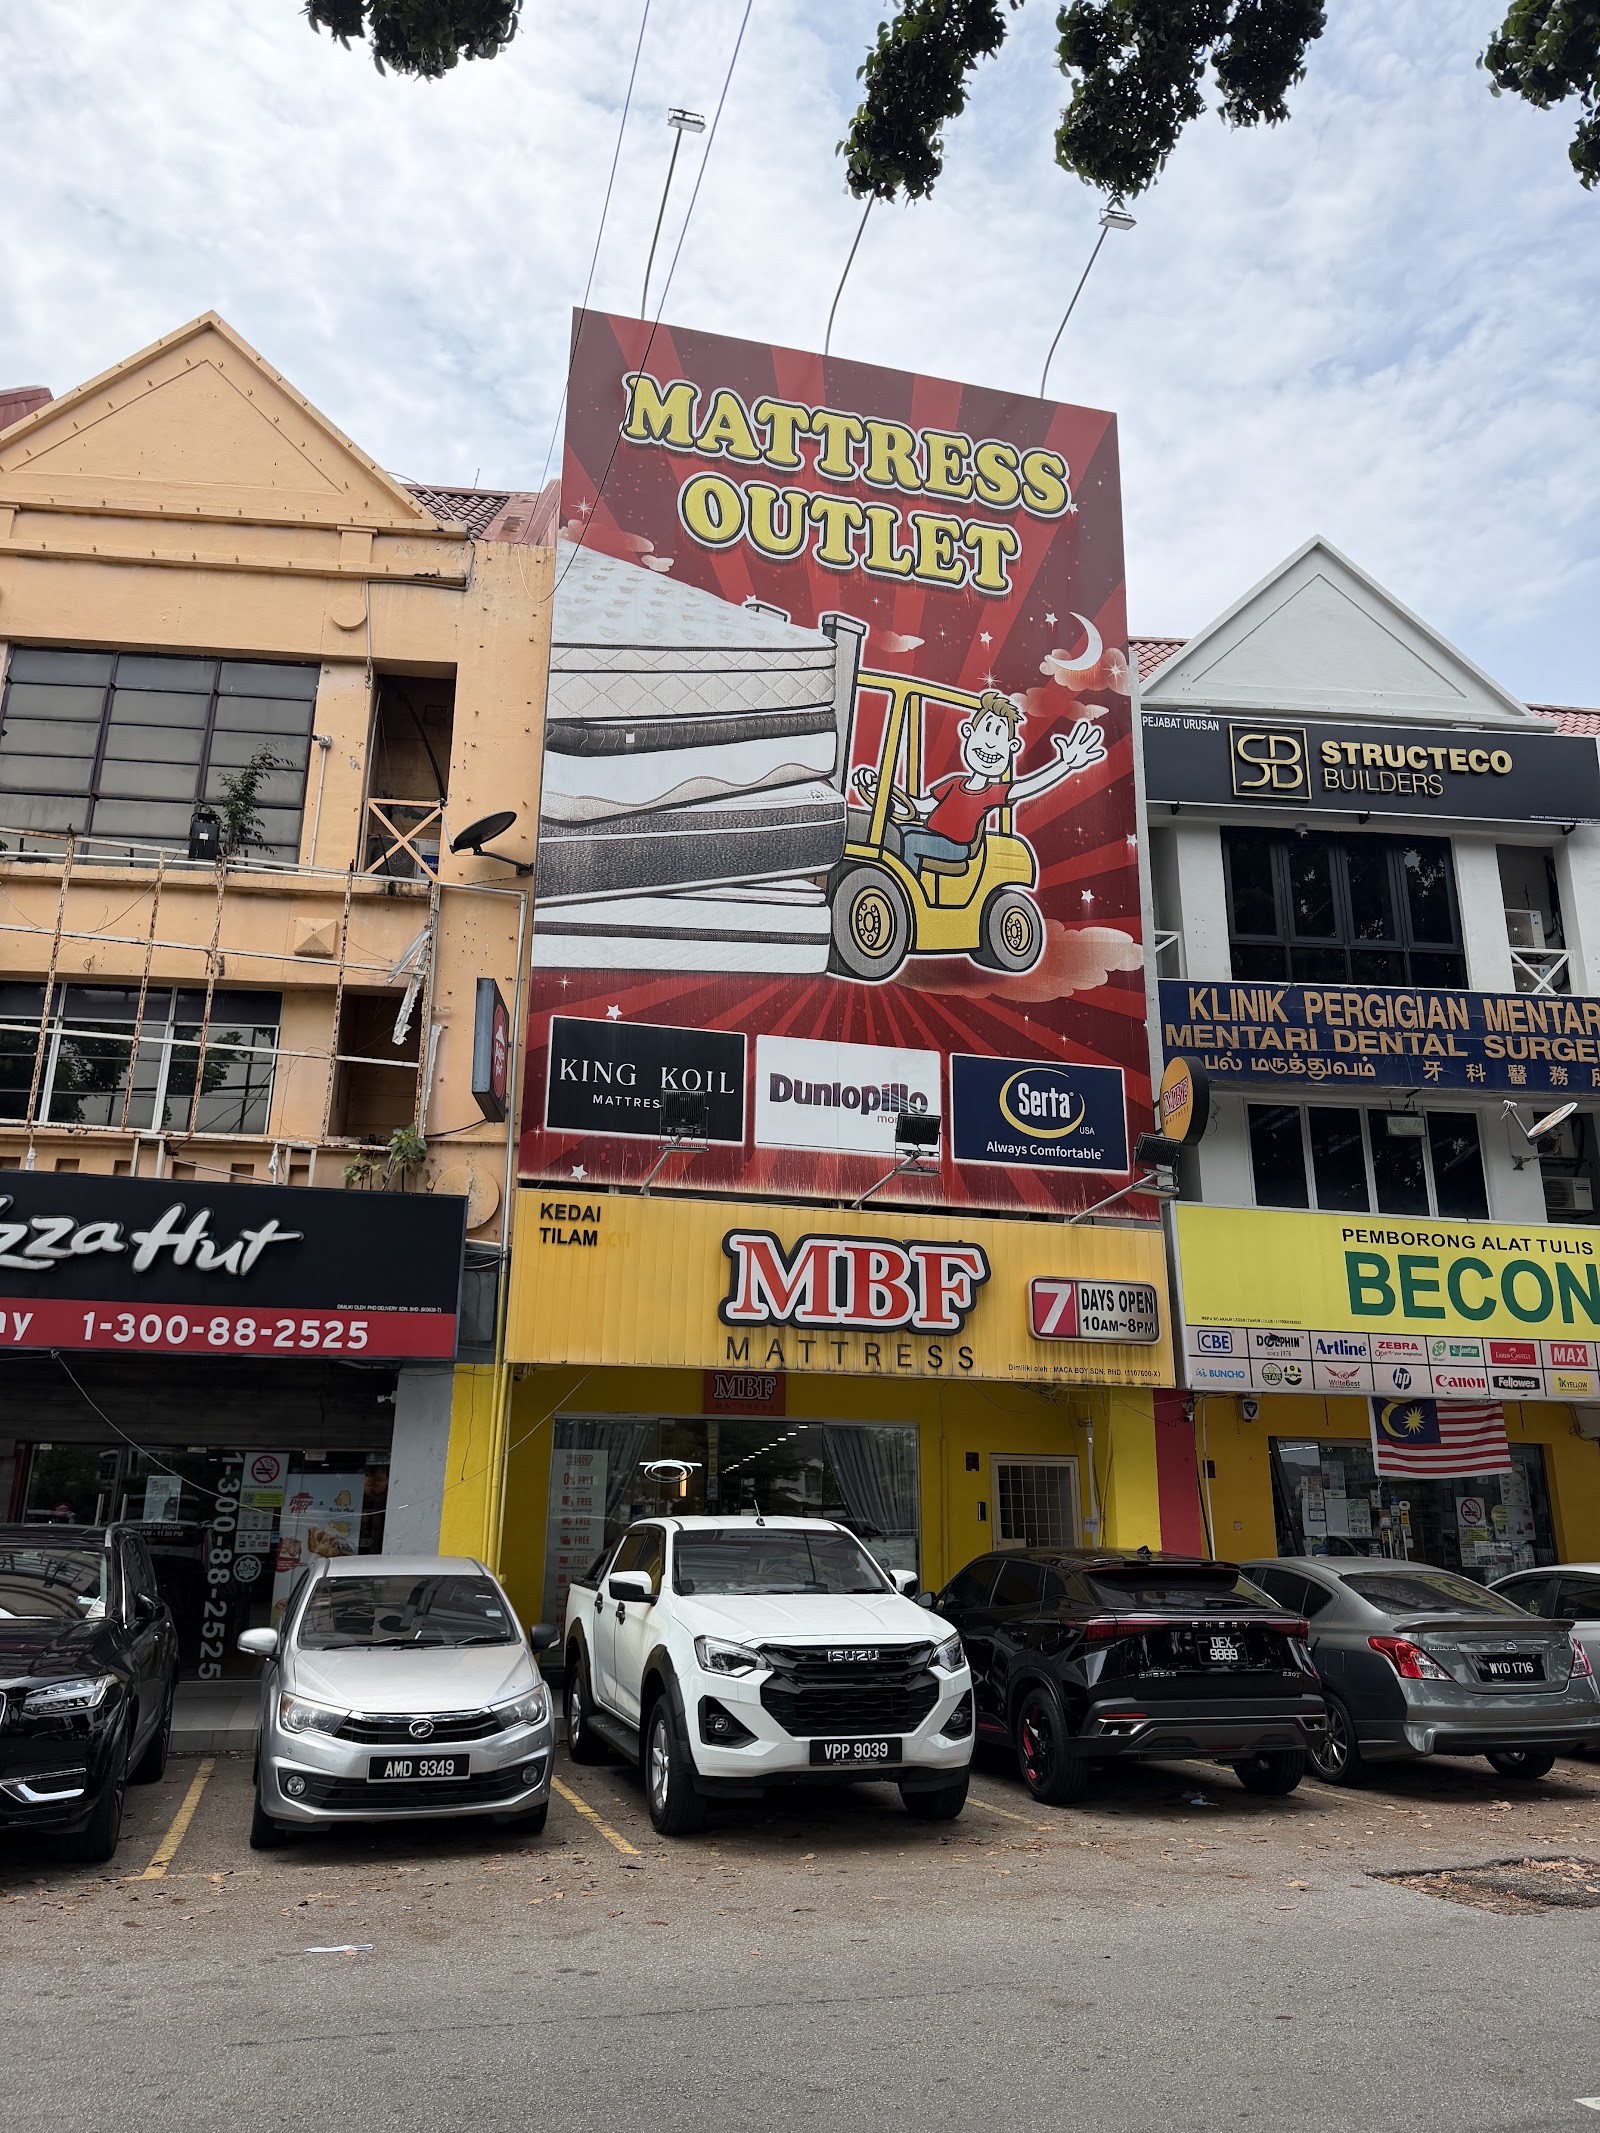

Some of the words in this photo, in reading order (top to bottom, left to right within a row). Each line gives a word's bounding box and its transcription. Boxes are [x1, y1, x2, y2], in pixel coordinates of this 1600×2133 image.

[623, 372, 1069, 516] MATTRESS
[679, 472, 1018, 594] OUTLET
[1142, 716, 1181, 730] PEJABAT
[1183, 718, 1219, 731] URUSAN
[1321, 740, 1514, 775] STRUCTECO
[1323, 768, 1445, 797] BUILDERS
[1189, 987, 1288, 1023] KLINIK
[1305, 992, 1470, 1032] PERGIGIAN
[1165, 1024, 1317, 1052] MENTARI
[1335, 1030, 1471, 1057] DENTAL
[1483, 1034, 1600, 1065] SURGE
[1204, 1050, 1243, 1071] பல்
[1251, 1052, 1376, 1080] மருத்துவம்
[559, 1058, 638, 1087] KING
[660, 1066, 735, 1095] KOIL
[769, 1072, 929, 1116] Dunlopillo
[1018, 1082, 1071, 1119] Serta
[1163, 1076, 1189, 1117] MBF
[1079, 1126, 1095, 1136] USA
[986, 1141, 1027, 1157] Always
[1029, 1143, 1102, 1160] Comfortable
[540, 1203, 601, 1223] KEDAI
[132, 1202, 302, 1276] Hut
[539, 1227, 598, 1247] TILAM
[1341, 1228, 1476, 1249] PEMBORONG
[1481, 1236, 1531, 1252] ALAT
[1536, 1239, 1594, 1255] TULIS
[718, 1229, 991, 1335] MBF
[1034, 1282, 1072, 1334] 7
[1081, 1288, 1114, 1311] DAYS
[1119, 1290, 1155, 1314] OPEN
[82, 1311, 369, 1350] 1-300-88-2525
[1082, 1315, 1155, 1335] 10AM~8PM
[1201, 1334, 1230, 1350] CBE
[1256, 1333, 1300, 1348] DOLPHIN
[1315, 1338, 1367, 1357] Artline
[1377, 1341, 1419, 1351] ZEBRA
[726, 1338, 974, 1370] MATTRESS
[1553, 1346, 1586, 1363] MAX
[1008, 1363, 1033, 1372] Dimiliki
[1034, 1365, 1048, 1373] oleh
[1053, 1366, 1073, 1374] MACA
[1074, 1367, 1089, 1375] BOY
[1209, 1370, 1245, 1379] BUNCHO
[1262, 1372, 1282, 1381] STAR
[1394, 1367, 1411, 1388] hp
[713, 1375, 777, 1400] MBF
[1329, 1379, 1361, 1387] WriteBest
[1435, 1373, 1486, 1389] Canon
[1498, 1376, 1536, 1389] Fellowes
[715, 1402, 774, 1411] MATTRESS
[578, 1475, 594, 1485] FREE
[290, 1498, 313, 1507] Pizza
[577, 1497, 593, 1506] FREE
[575, 1517, 591, 1526] FREE
[574, 1535, 590, 1545] FREE
[198, 1452, 244, 1680] 1-300-88-2525
[573, 1556, 588, 1565] FREE
[1210, 1636, 1233, 1649] DEX
[828, 1650, 880, 1663] ISUZU
[1489, 1662, 1511, 1674] WYD
[1512, 1662, 1534, 1674] 1716
[824, 1743, 850, 1760] VPP
[854, 1741, 888, 1759] 9039
[384, 1760, 413, 1778] AMD
[419, 1759, 455, 1776] 9349
